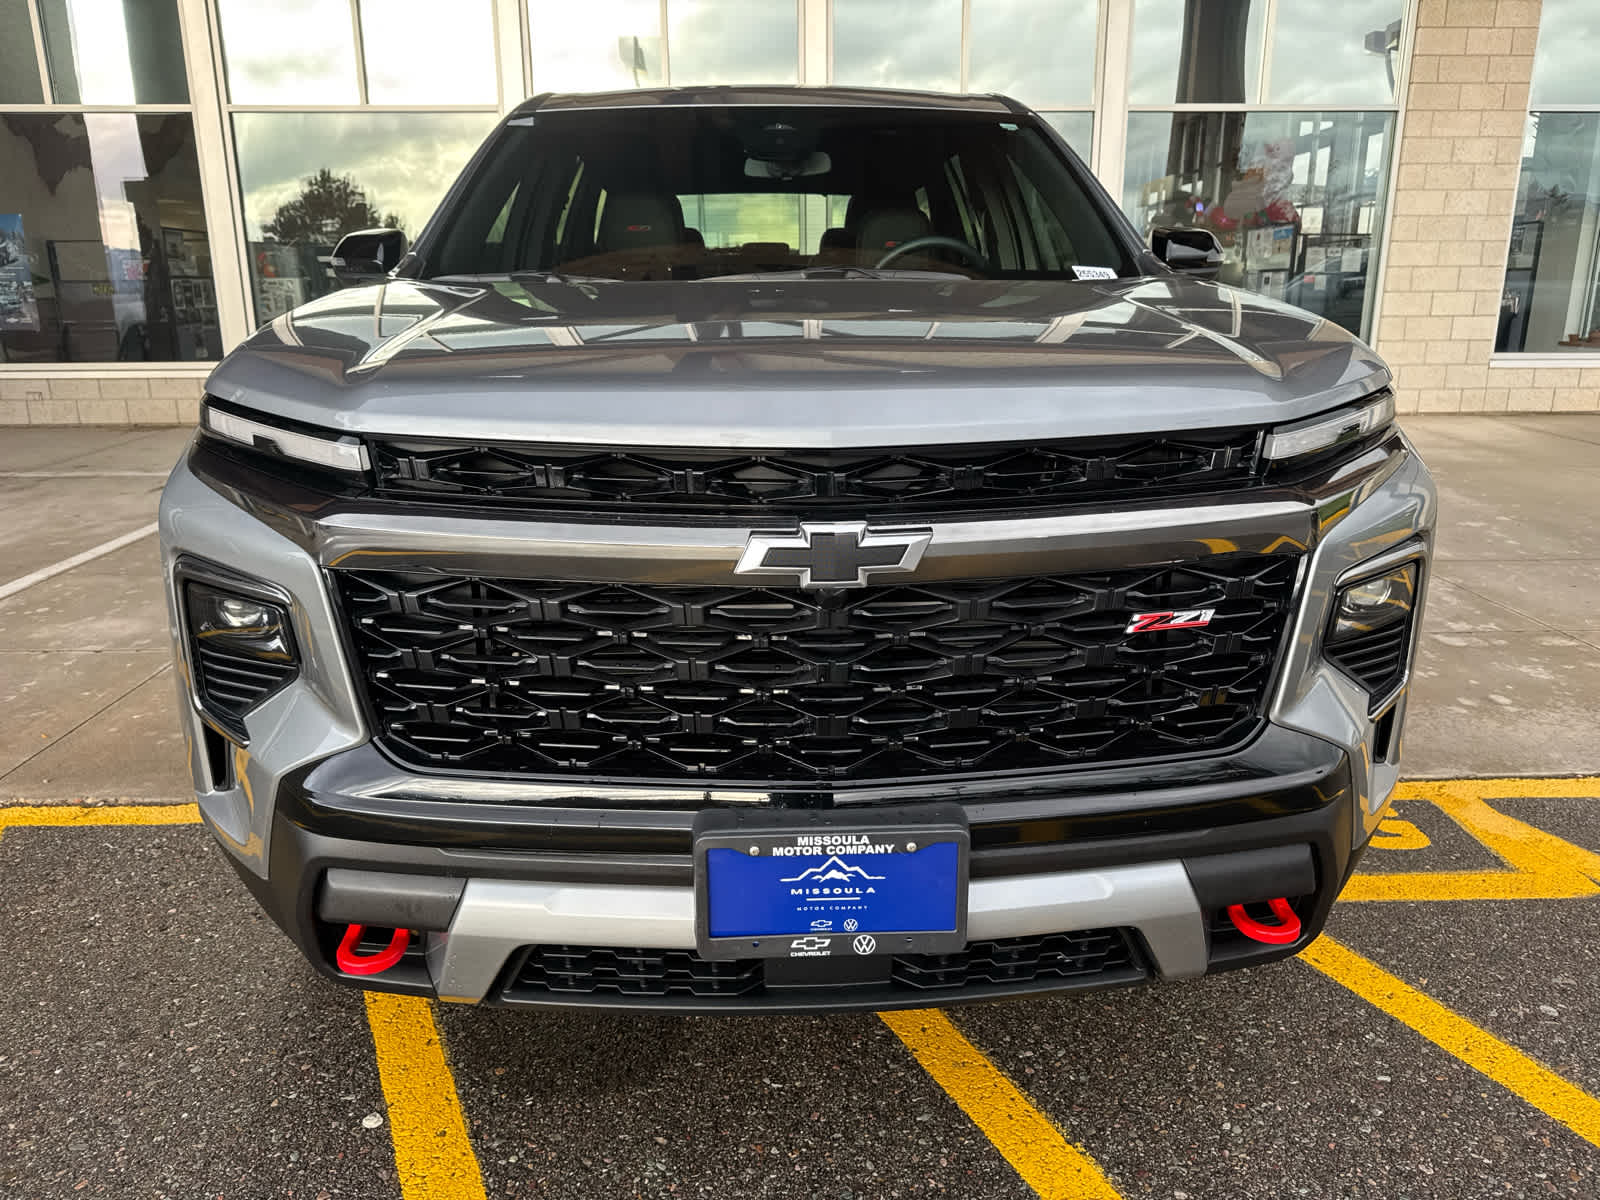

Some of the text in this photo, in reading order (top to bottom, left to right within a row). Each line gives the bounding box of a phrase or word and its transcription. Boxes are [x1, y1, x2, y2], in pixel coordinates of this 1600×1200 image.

[1124, 608, 1216, 634] Z71
[797, 835, 870, 846] MISSOULA
[772, 844, 895, 857] MOTOR COMPANY
[790, 887, 876, 895] MISSOULA
[790, 950, 832, 958] CHEVROLET
